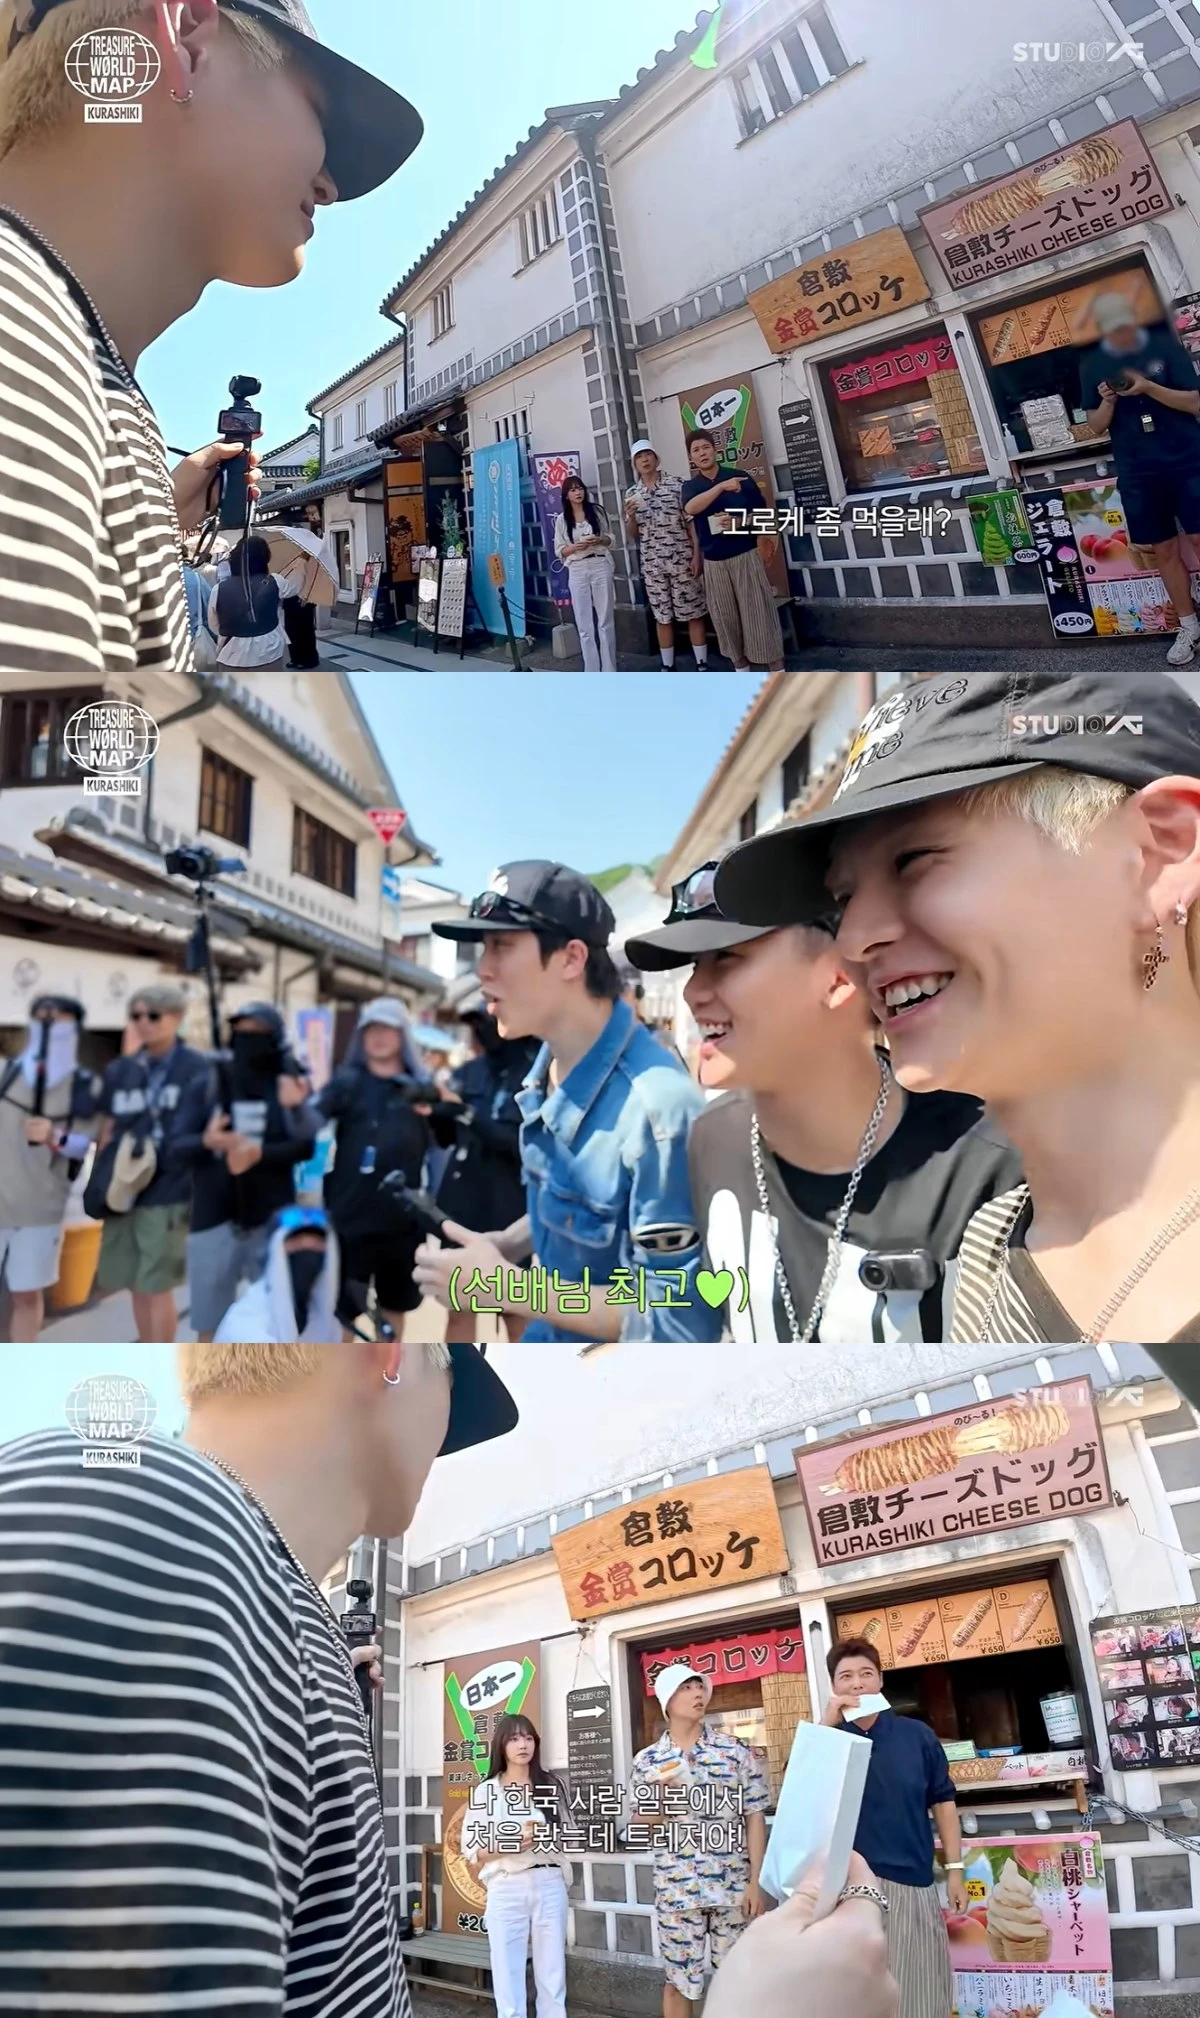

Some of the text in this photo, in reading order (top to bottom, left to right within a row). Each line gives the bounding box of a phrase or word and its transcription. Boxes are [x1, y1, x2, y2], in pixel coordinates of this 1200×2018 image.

[944, 164, 1152, 269] 倉敷チーズドッグ
[952, 194, 1165, 285] KURASHIKI CHEESE DOG
[797, 259, 852, 297] 倉敷
[774, 275, 905, 343] 金賞コロッケ
[836, 341, 954, 393] 金賞コロッケ
[699, 396, 737, 426] 日本一
[1046, 499, 1072, 537] 倉敷
[1027, 502, 1062, 594] ジェラート
[817, 1441, 1098, 1536] 倉敷チーズドッグ
[621, 1500, 693, 1547] 倉敷
[821, 1482, 1103, 1559] KURASHIKI CHEESE DOG
[579, 1531, 760, 1608] 金賞コロッケ
[924, 1654, 946, 1663] ¥650
[981, 1645, 1004, 1654] ¥650
[1036, 1636, 1061, 1646] ¥650
[466, 1672, 516, 1706] 日本一
[1061, 1849, 1085, 1956] 白桃シャーベット
